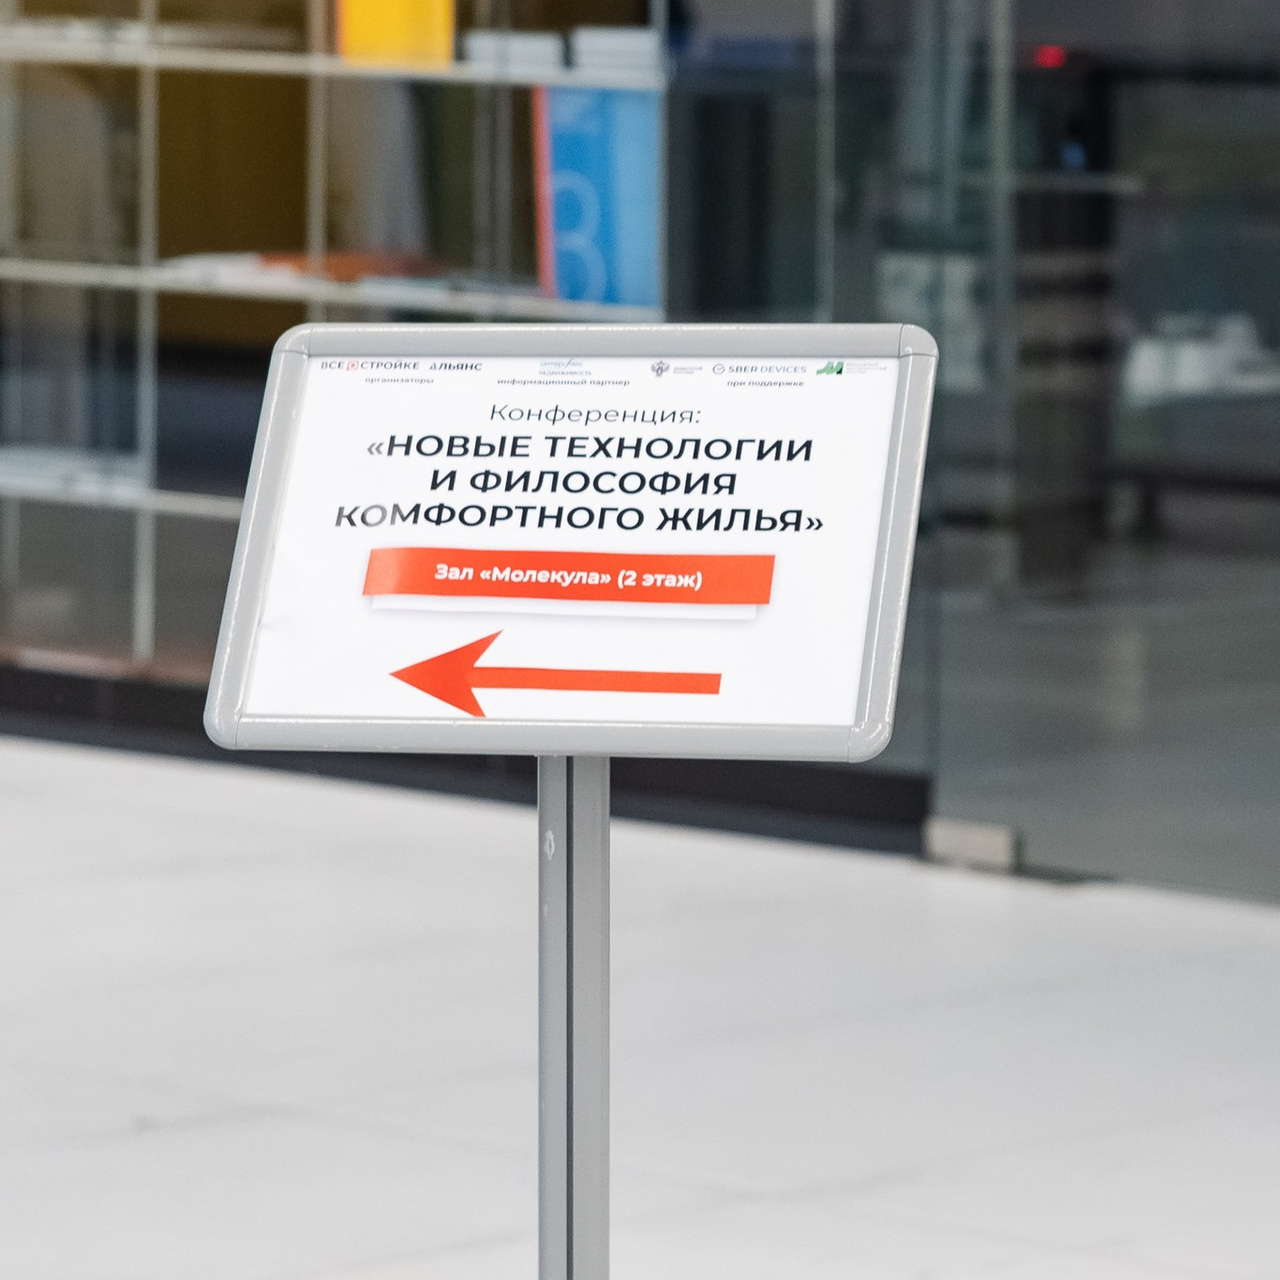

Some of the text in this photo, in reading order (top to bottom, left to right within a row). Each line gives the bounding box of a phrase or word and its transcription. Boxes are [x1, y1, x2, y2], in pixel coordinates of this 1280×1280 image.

[320, 361, 345, 370] ВСЕ
[360, 360, 420, 370] СТРОЙКЕ
[728, 365, 808, 373] SBER DEVICES
[364, 376, 434, 385] организаторы
[496, 378, 630, 387] информационный партнер
[726, 380, 805, 388] при поддержке
[490, 404, 702, 426] Конференция:
[367, 435, 813, 461] «НОВЫЕ ТЕХНОЛОГИИ
[430, 469, 737, 495] И ФИЛОСОФИЯ
[335, 503, 824, 532] КОМФОРТНОГО ЖИЛЬЯ»
[434, 563, 703, 591] Зал «Молекула» (2 этаж)
